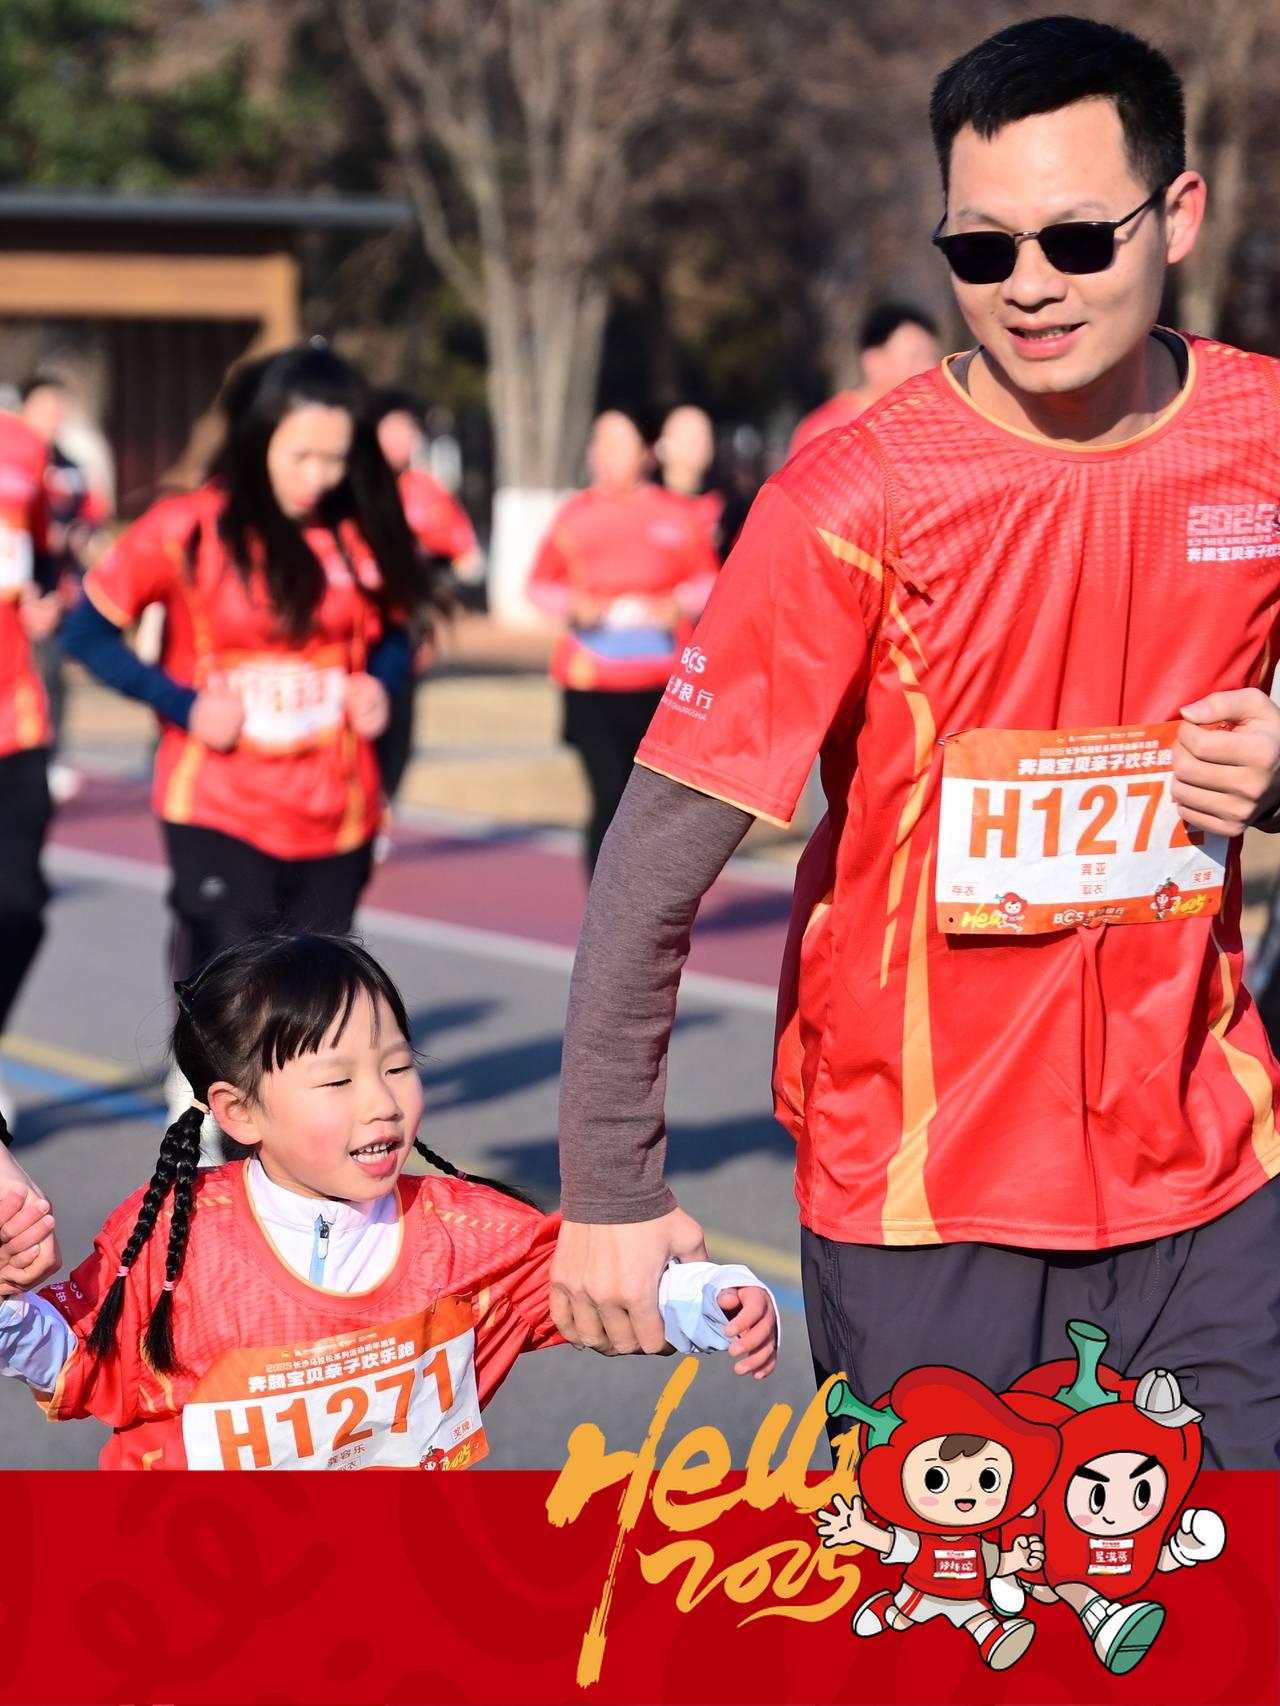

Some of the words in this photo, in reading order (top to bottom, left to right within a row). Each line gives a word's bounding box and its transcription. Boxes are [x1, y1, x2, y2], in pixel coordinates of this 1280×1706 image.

[680, 646, 707, 674] BCS
[1053, 908, 1086, 926] BCS
[247, 1340, 416, 1394] 奔腾宝贝亲子欢乐跑
[214, 1348, 454, 1470] H1271
